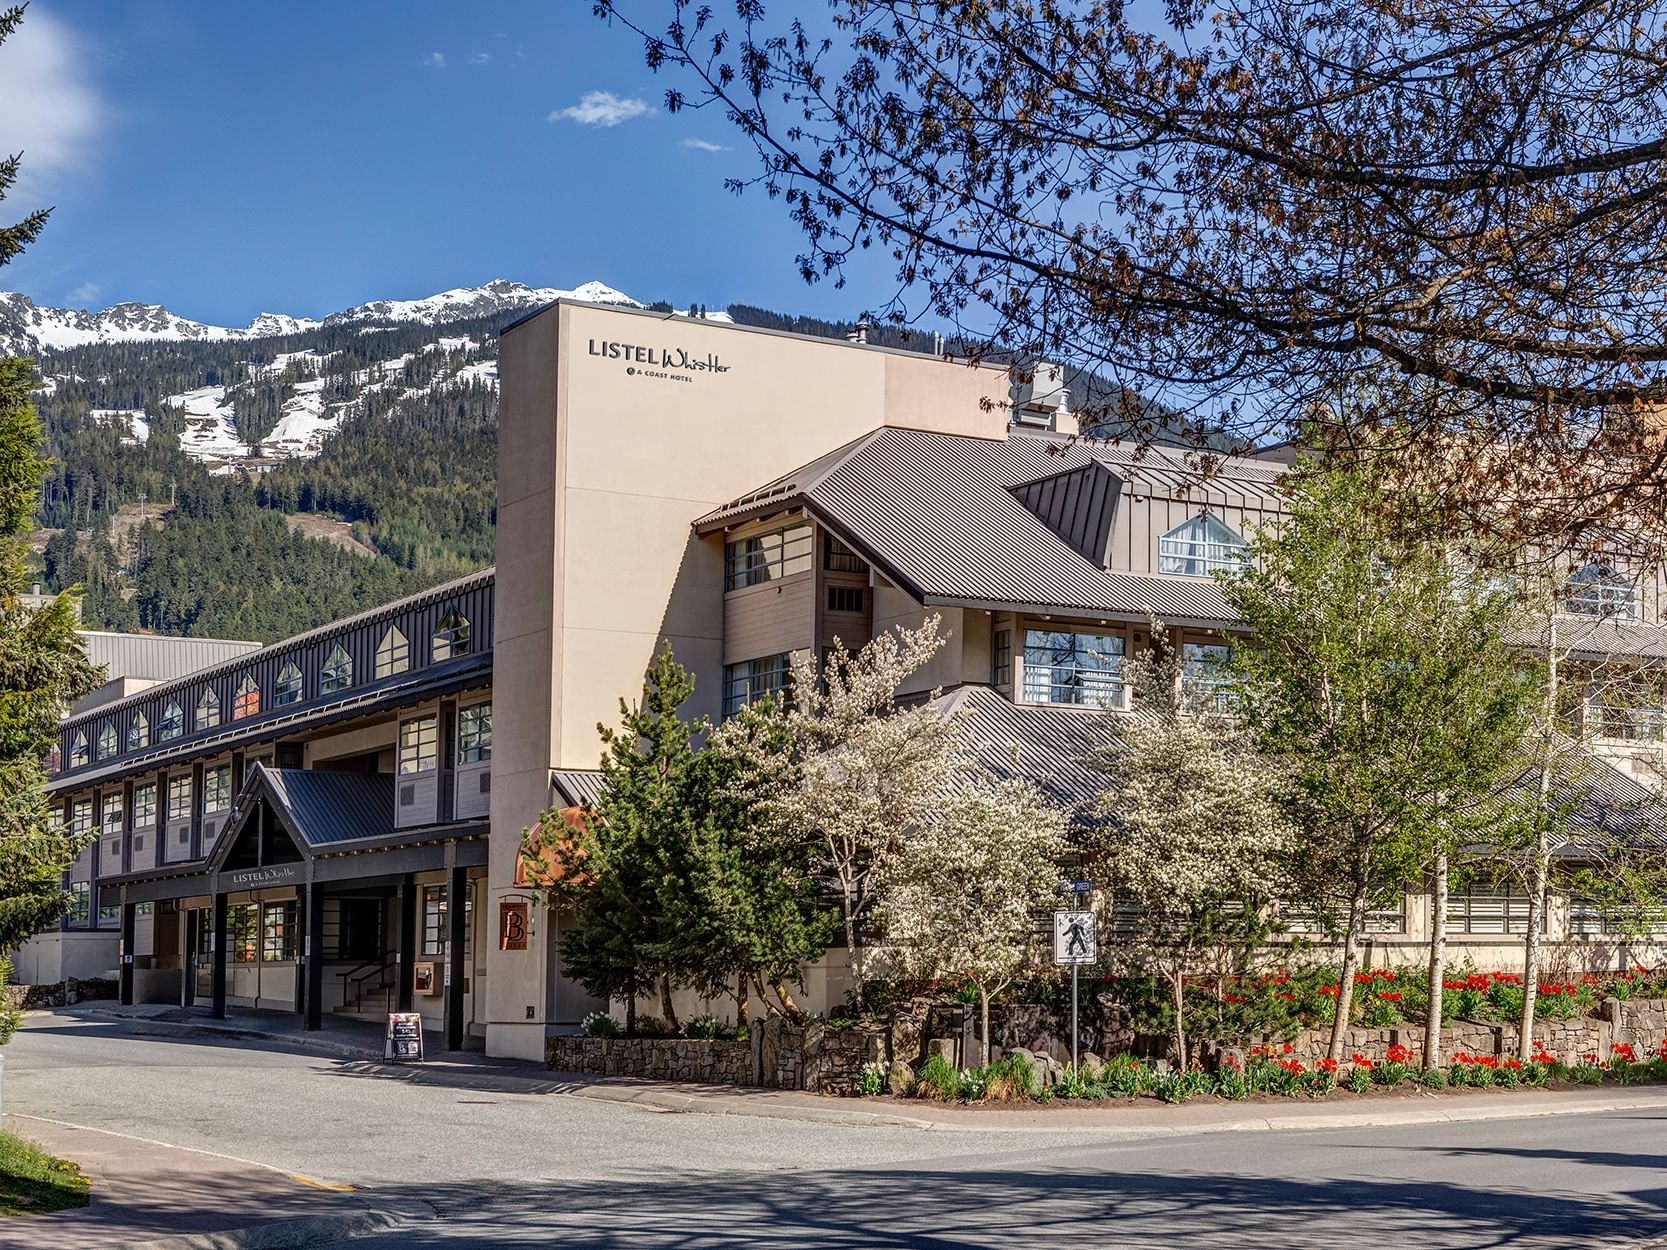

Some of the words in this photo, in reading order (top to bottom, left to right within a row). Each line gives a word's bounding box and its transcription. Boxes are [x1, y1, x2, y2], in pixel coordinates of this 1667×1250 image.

[588, 339, 660, 364] LISTEL
[662, 348, 731, 373] Whistler
[644, 370, 668, 379] COAST
[670, 374, 693, 383] HOTEL
[233, 872, 264, 883] LISTEL
